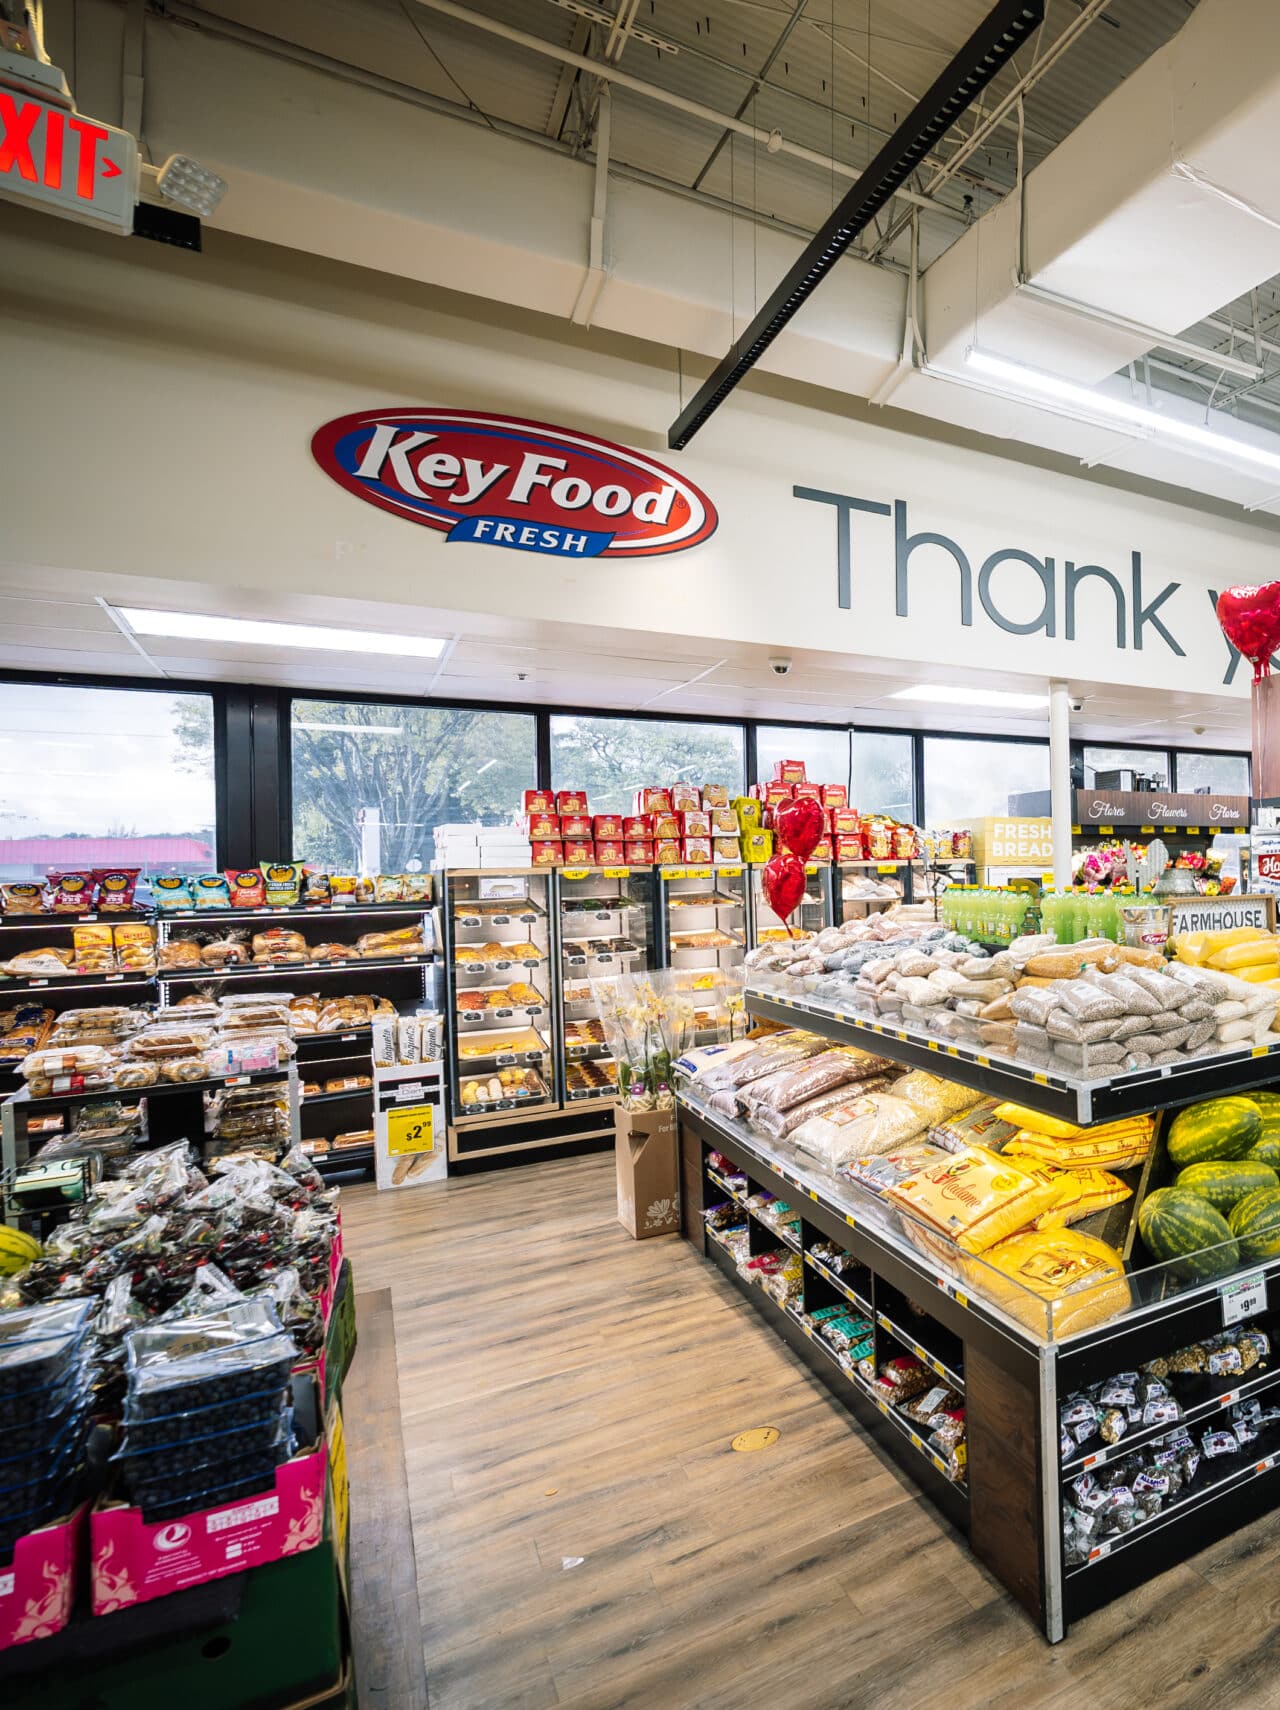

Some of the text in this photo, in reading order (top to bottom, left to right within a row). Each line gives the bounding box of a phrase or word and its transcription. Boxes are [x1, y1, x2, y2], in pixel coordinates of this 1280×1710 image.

[0, 91, 109, 201] XIT
[351, 422, 679, 526] Key Food
[472, 519, 589, 553] FRESH
[792, 485, 1186, 657] Thank
[1088, 800, 1126, 819] Flores
[1147, 801, 1189, 819] Flowers
[1208, 803, 1241, 820] Flores
[993, 823, 1053, 840] FRESH
[992, 841, 1054, 857] BREAD
[941, 1174, 982, 1208] Madame
